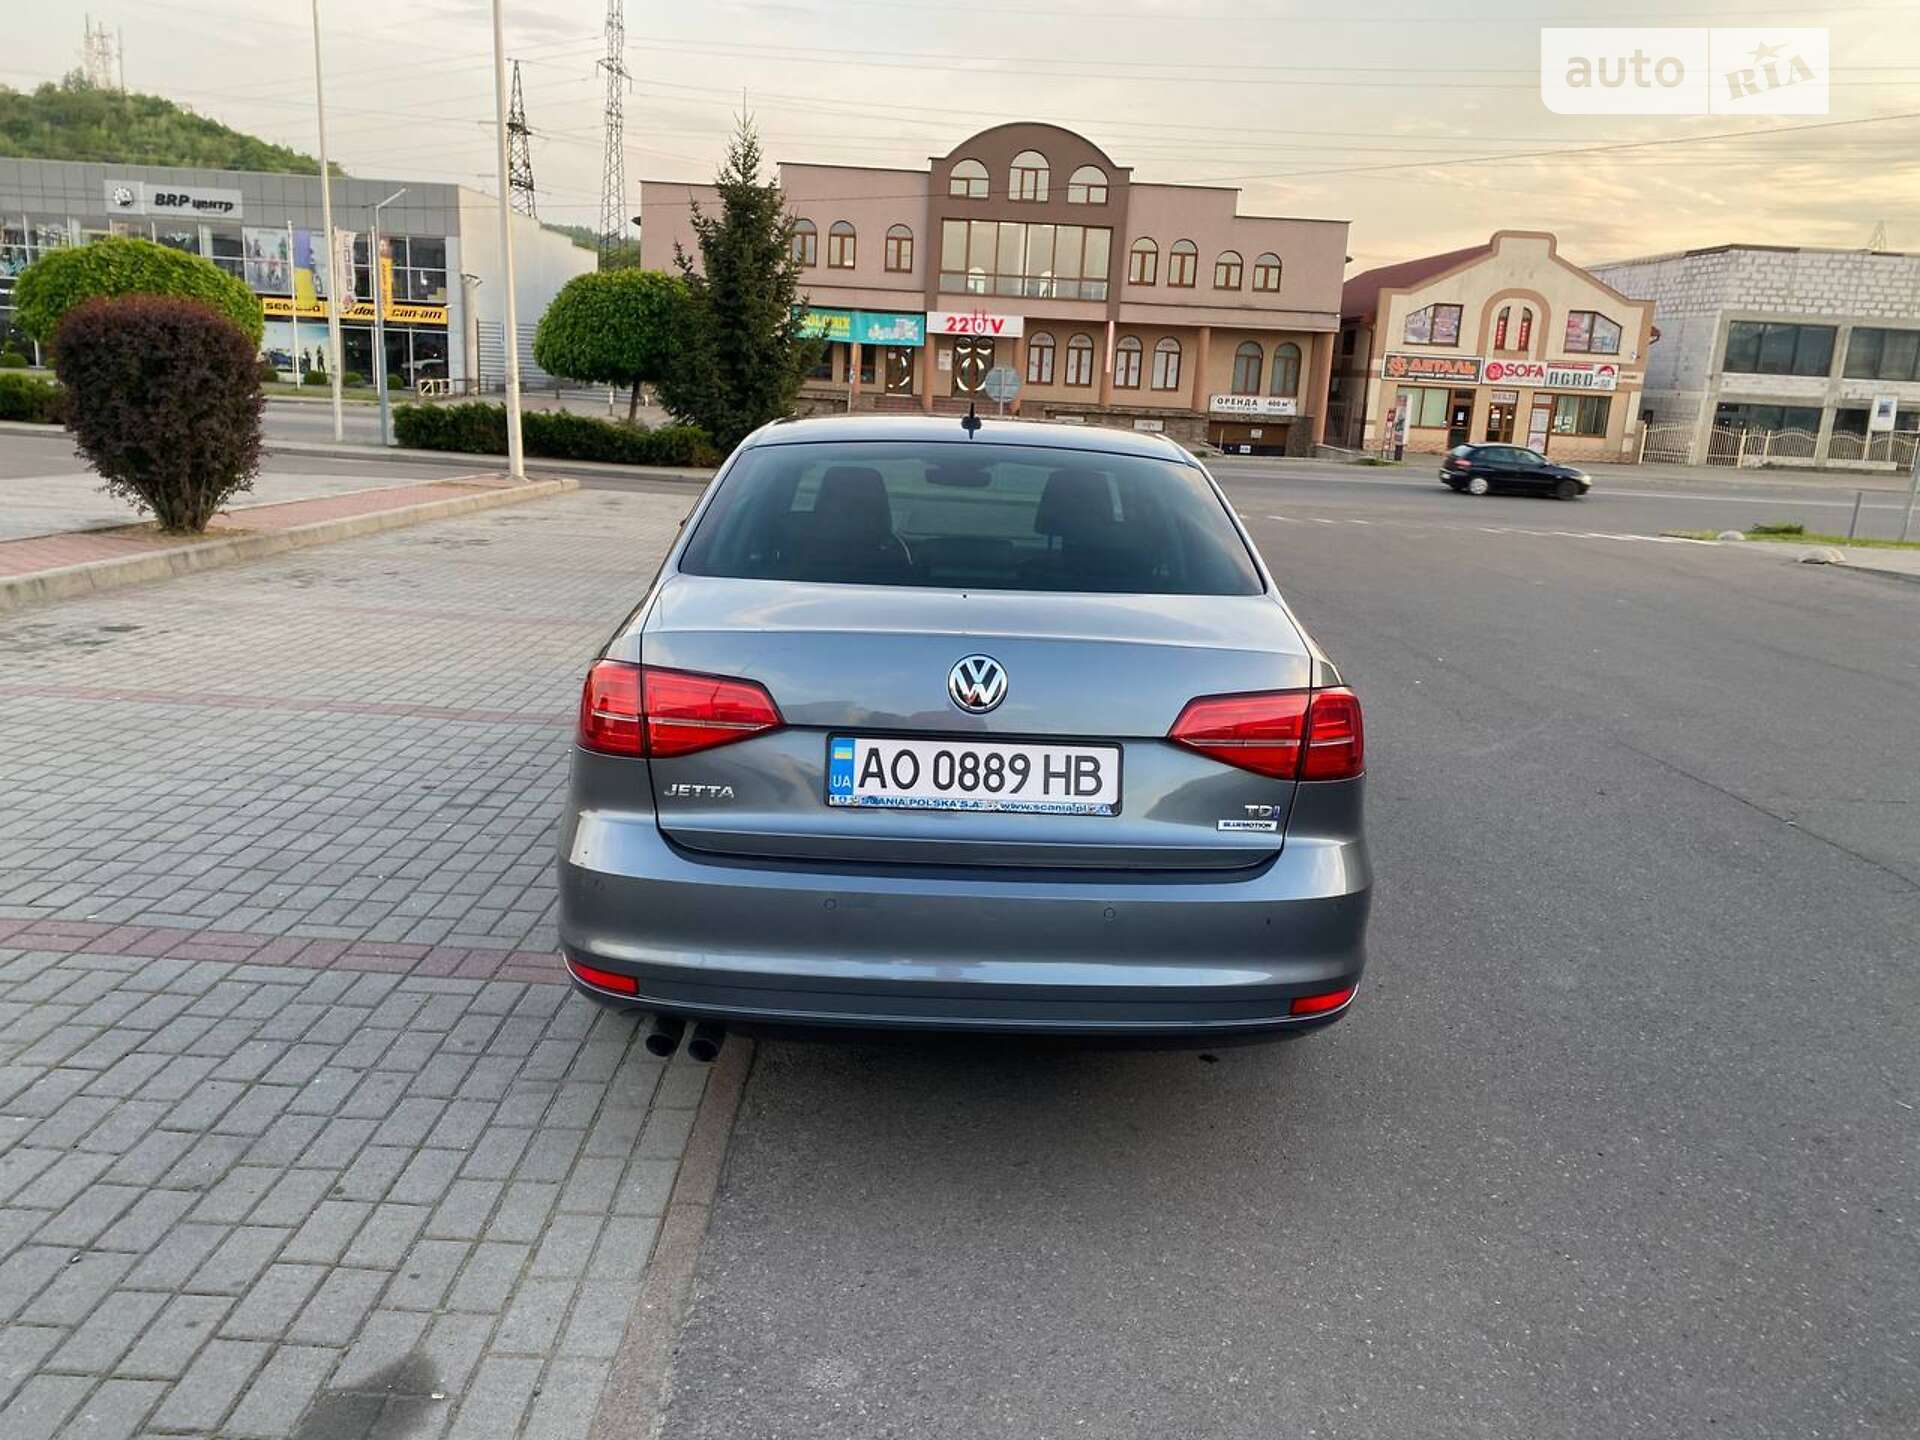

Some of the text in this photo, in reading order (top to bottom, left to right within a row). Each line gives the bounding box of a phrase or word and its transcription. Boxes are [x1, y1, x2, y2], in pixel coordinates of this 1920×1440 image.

[154, 193, 234, 213] BRP центр
[1503, 363, 1544, 378] SOFA
[1216, 396, 1258, 407] ОРЕНДА
[857, 747, 1104, 797] AO 0889 HB
[832, 776, 852, 788] UA
[664, 784, 735, 799] JETTA
[1244, 804, 1281, 819] TDI
